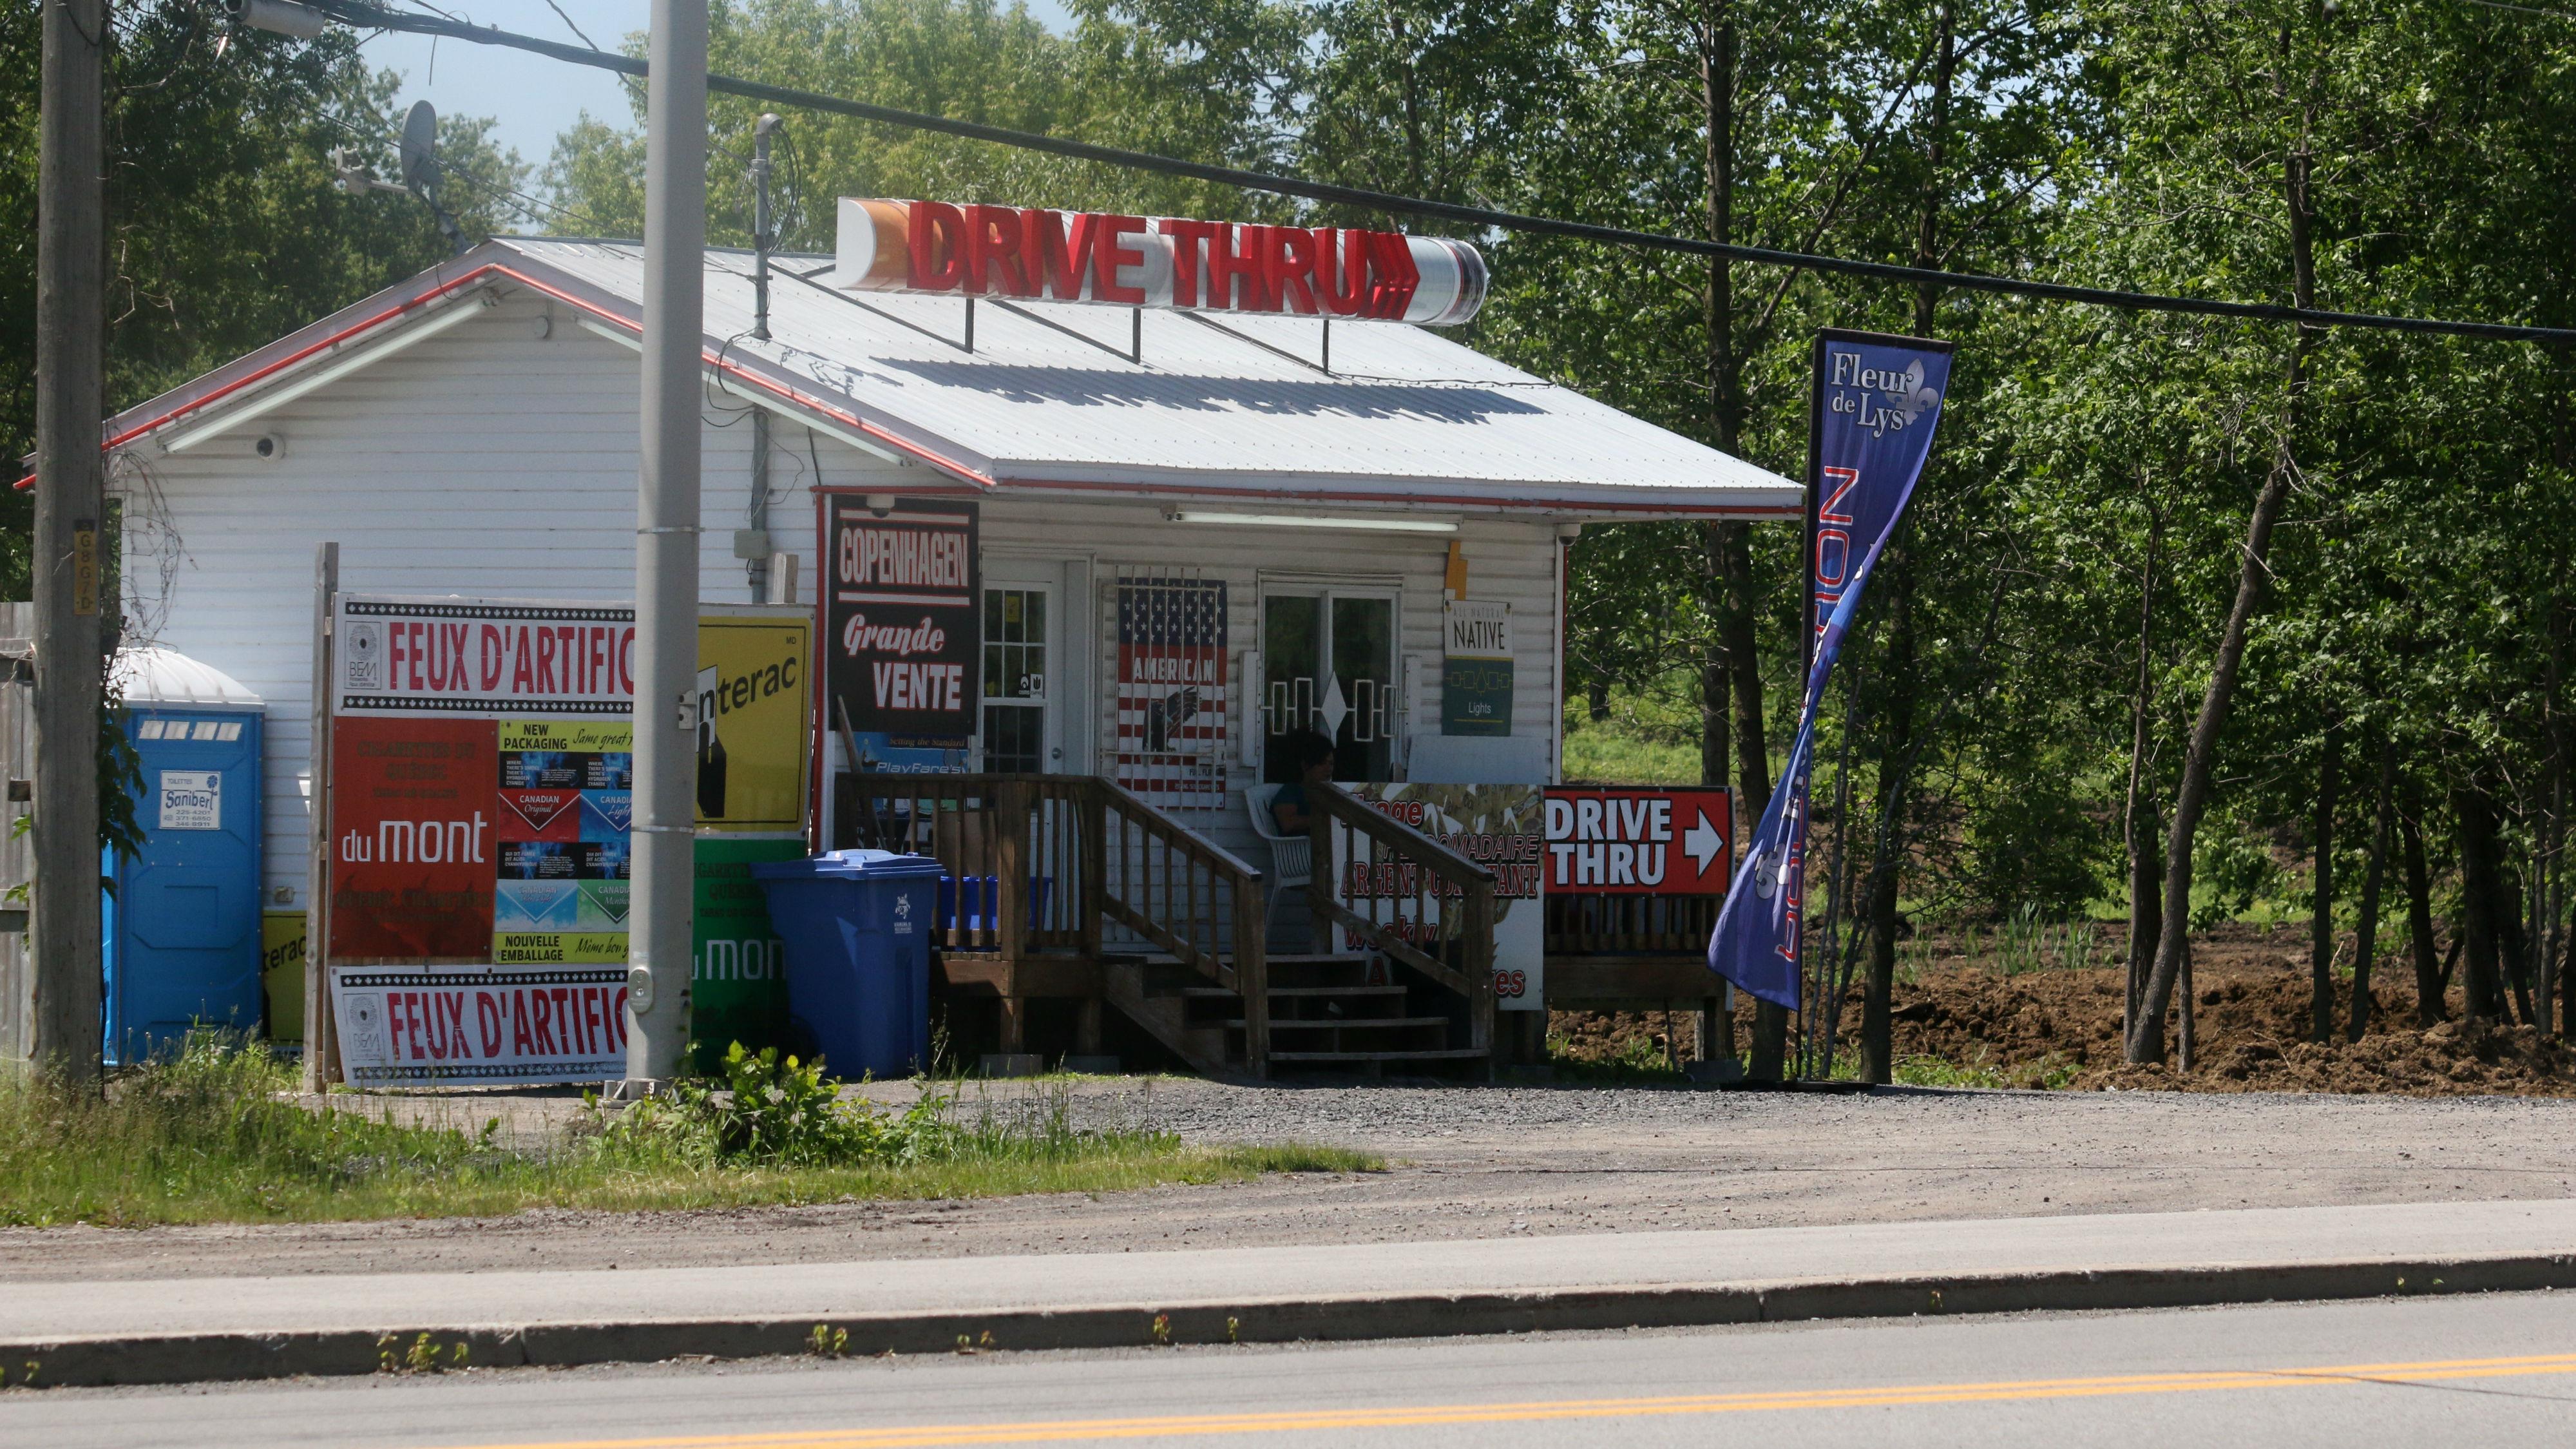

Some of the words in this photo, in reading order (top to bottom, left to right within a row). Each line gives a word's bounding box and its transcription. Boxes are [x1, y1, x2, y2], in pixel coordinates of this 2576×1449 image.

[906, 200, 1147, 305] DRIVE
[1158, 218, 1368, 316] THRU
[1830, 352, 1914, 394] Fleur
[1832, 390, 1855, 414] de
[1858, 392, 1904, 438] Lys
[839, 528, 968, 586] COPENHAGEN
[844, 614, 946, 656] Grande
[1453, 620, 1505, 649] NATIVE
[350, 661, 376, 677] BEM
[389, 622, 469, 691] FEUX
[481, 624, 634, 695] D'ARTIFIC
[1134, 657, 1215, 682] AMERICAN
[698, 657, 797, 723] nterac
[873, 662, 964, 710] VENTE
[1468, 702, 1492, 716] Lights
[524, 724, 549, 735] NEW
[573, 729, 599, 744] Same
[598, 732, 628, 749] great
[504, 738, 568, 749] PACKAGING
[889, 738, 915, 747] Setting
[931, 738, 965, 747] Standard
[876, 762, 960, 773] PlayFare's
[166, 790, 213, 811] Sanibert
[519, 795, 559, 803] CANADIAN
[524, 805, 553, 817] Original
[1545, 798, 1673, 841] DRIVE
[342, 829, 371, 862] du
[379, 811, 488, 863] mont
[1549, 843, 1666, 886] THRU
[518, 886, 557, 894] CANADIAN
[505, 936, 560, 947] NOUVELLE
[575, 937, 603, 954] Même
[604, 936, 622, 954] bon
[501, 949, 564, 961] EMBALLAGE
[386, 991, 472, 1061] FEUX
[477, 986, 628, 1058] D'ARTIFIC
[353, 1033, 380, 1048] BEM
